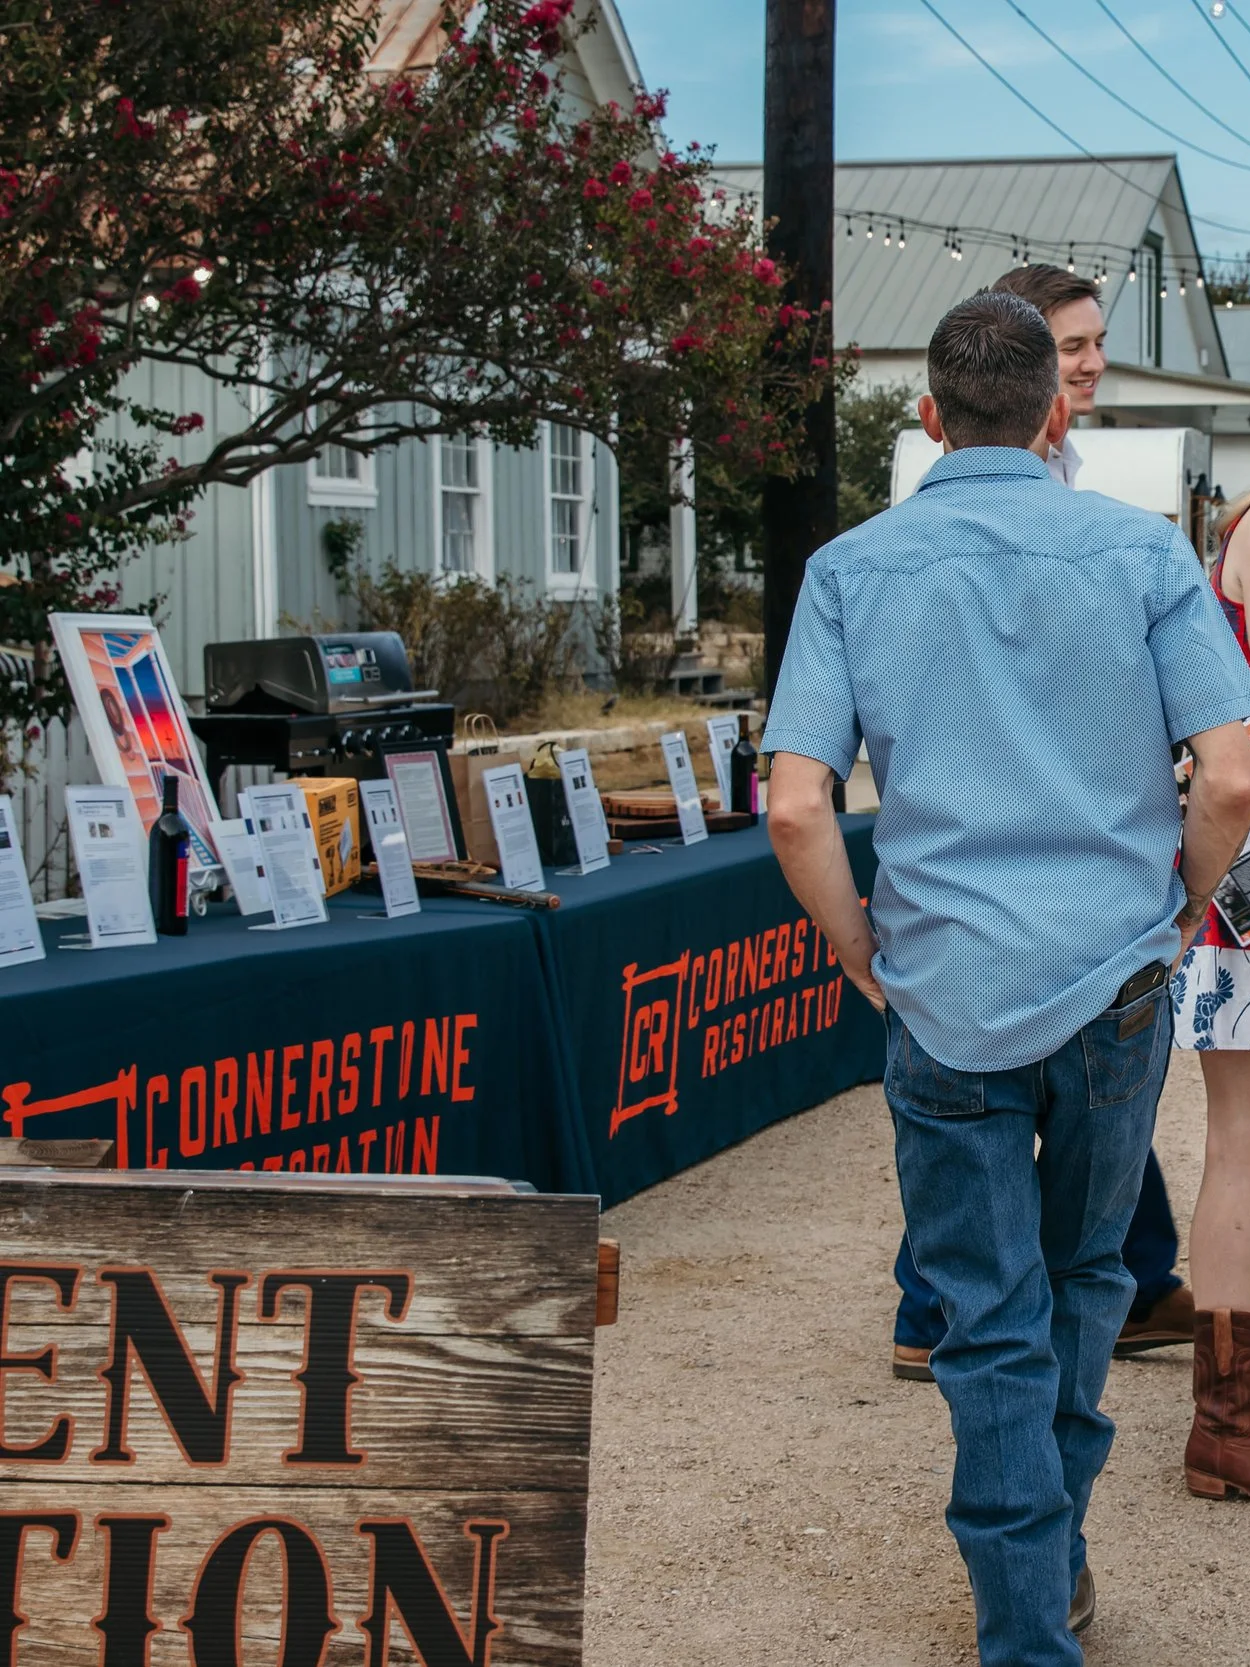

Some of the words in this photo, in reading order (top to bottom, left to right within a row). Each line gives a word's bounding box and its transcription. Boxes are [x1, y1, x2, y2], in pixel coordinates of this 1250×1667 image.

[688, 897, 868, 1029] CORNERST
[146, 1013, 478, 1172] CORNERSTONE
[629, 1000, 669, 1083] CR
